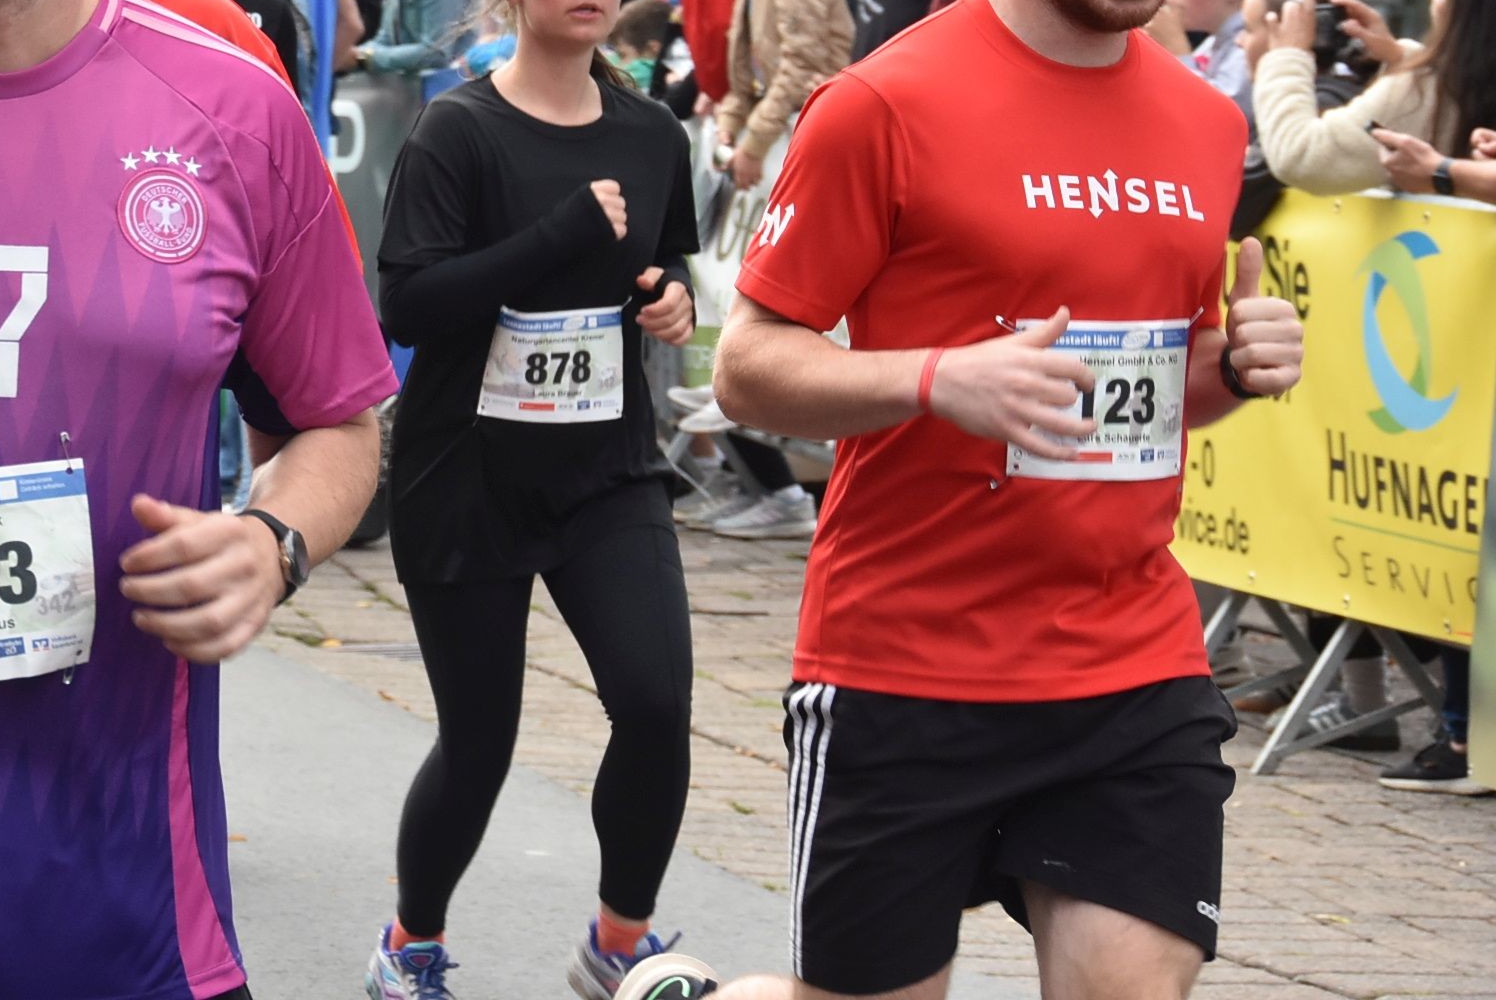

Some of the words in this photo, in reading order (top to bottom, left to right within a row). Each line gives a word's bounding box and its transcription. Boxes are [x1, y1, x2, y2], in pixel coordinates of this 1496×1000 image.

[141, 186, 188, 205] DEUTSCHER
[1022, 168, 1205, 220] HENSEL
[524, 350, 591, 385] 878
[1179, 497, 1250, 555] vice.de
[38, 590, 77, 616] 342
